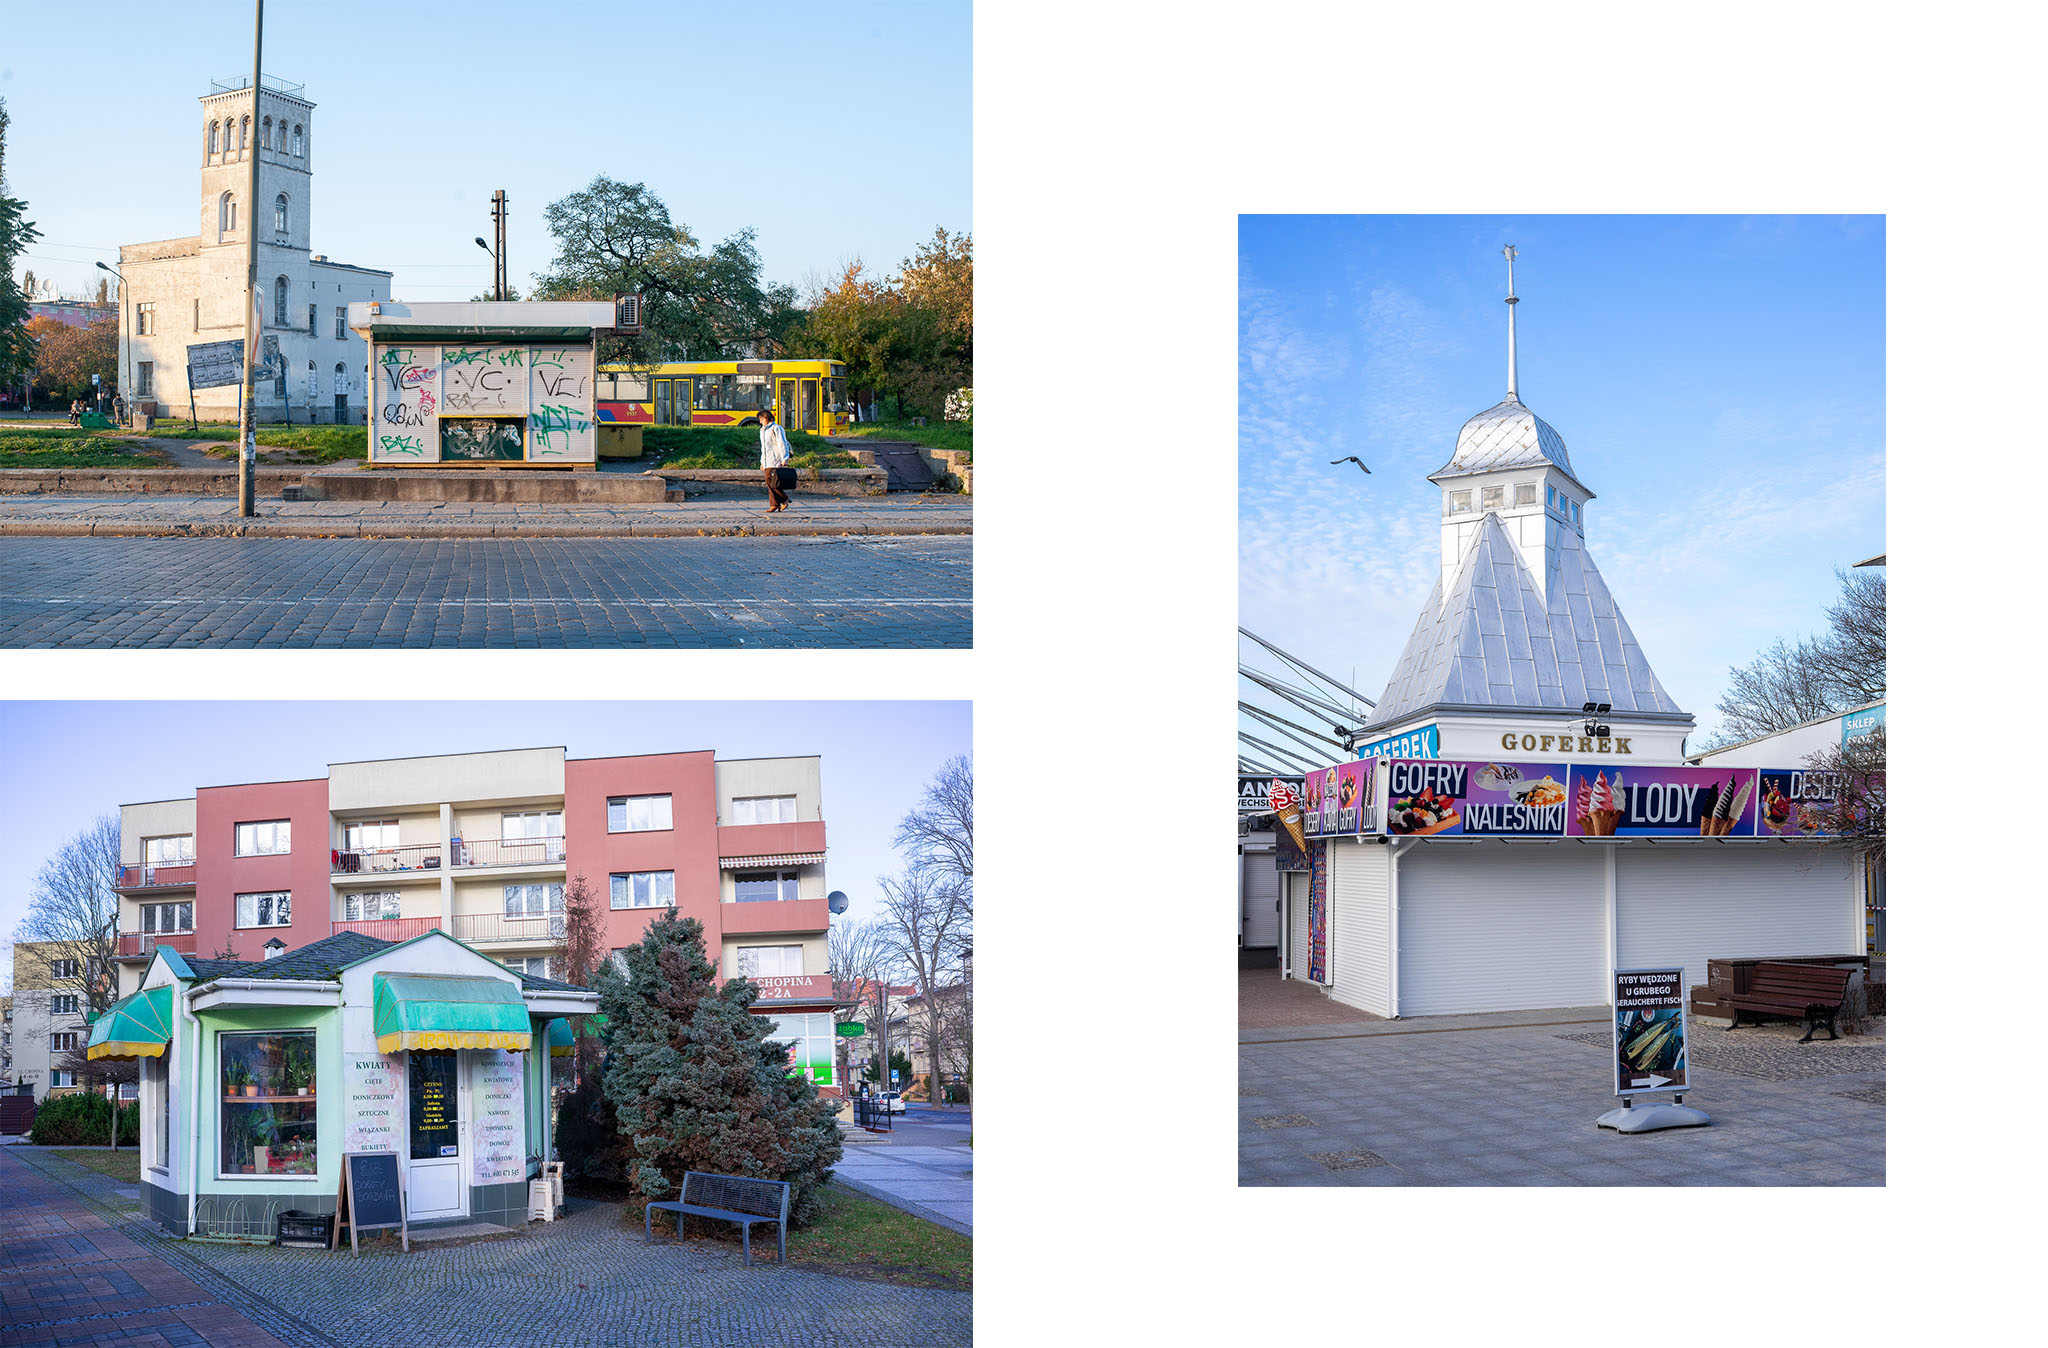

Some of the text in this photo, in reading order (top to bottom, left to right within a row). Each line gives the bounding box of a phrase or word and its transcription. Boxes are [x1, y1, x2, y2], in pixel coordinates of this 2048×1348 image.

[1847, 717, 1875, 730] SKLEP
[1501, 733, 1632, 754] GOFEREK
[1392, 762, 1466, 795] GOFRY
[1631, 782, 1700, 823] LODY
[757, 976, 813, 987] CHOPINA
[1618, 974, 1677, 985] RYBY WĘDZONE
[1626, 986, 1671, 996] U GRUBEGO
[356, 1061, 391, 1070] KWIATY
[352, 1093, 394, 1101] DONICZKOWE
[361, 1143, 388, 1151] BUKIETY
